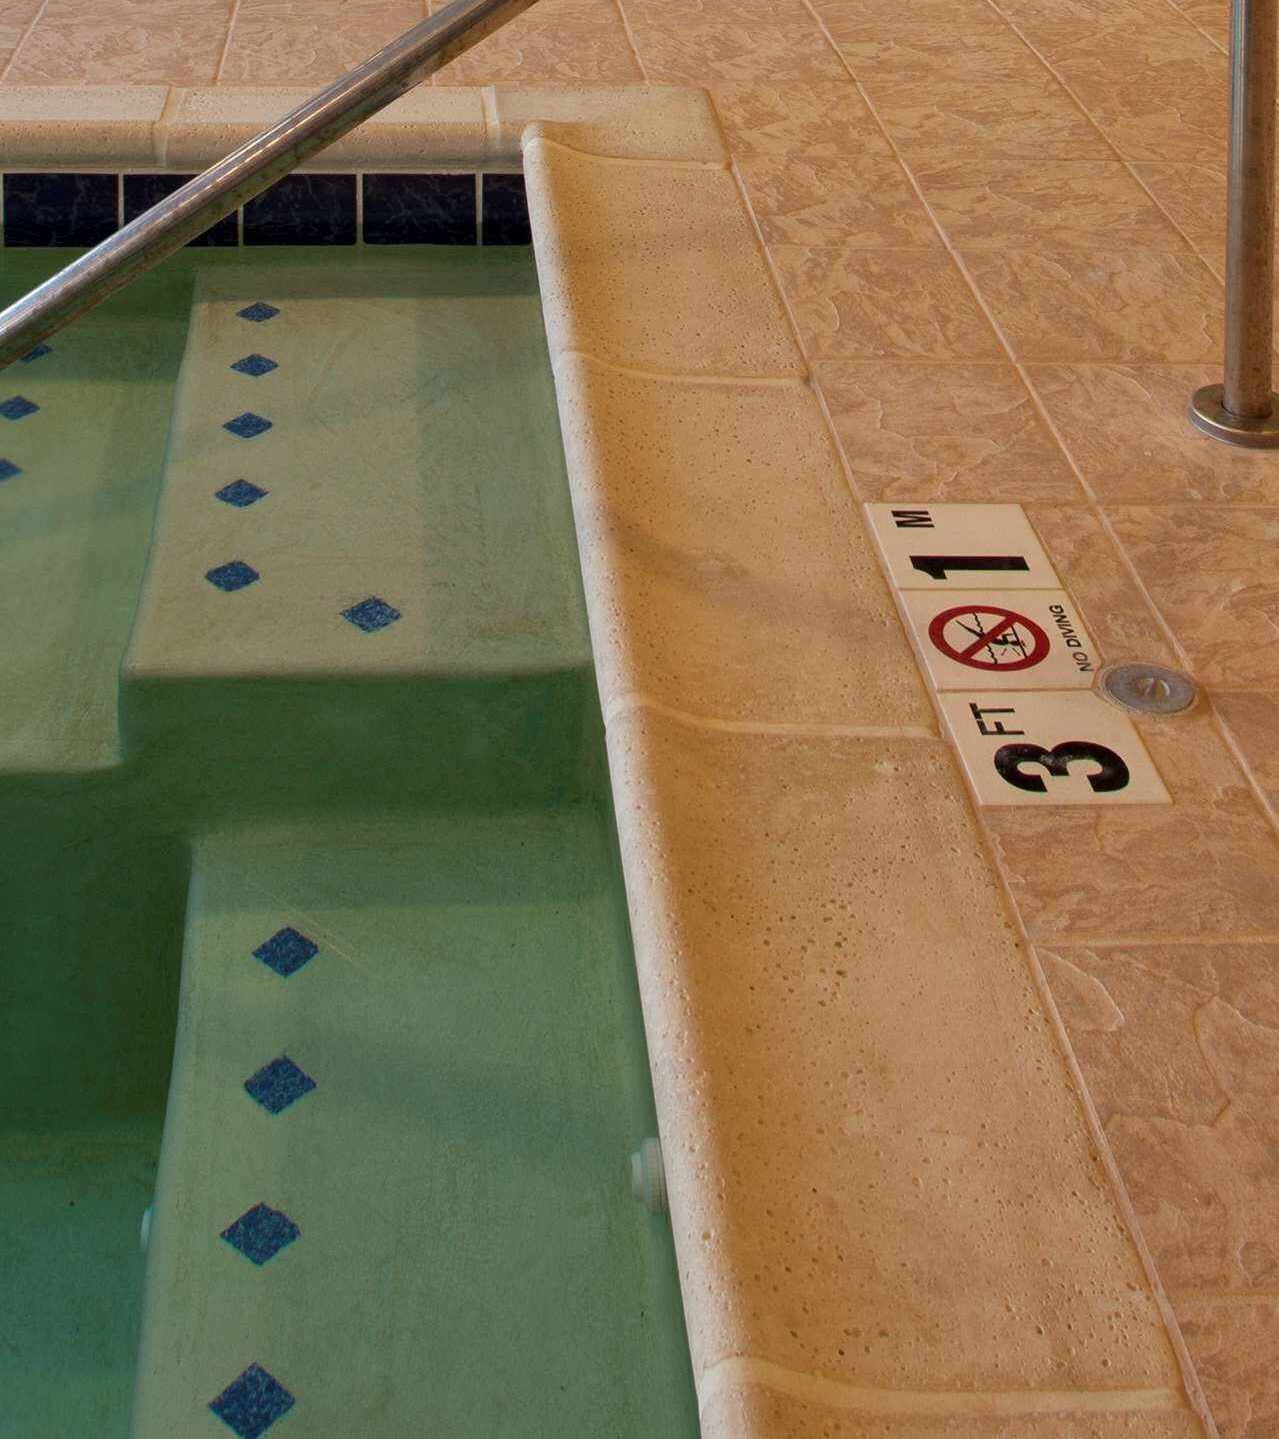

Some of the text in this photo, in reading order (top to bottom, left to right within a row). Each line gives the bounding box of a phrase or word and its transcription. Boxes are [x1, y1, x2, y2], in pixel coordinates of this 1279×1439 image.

[891, 510, 1030, 580] 1 M
[1048, 604, 1094, 672] NO DIVING
[969, 702, 1130, 793] 3 FT
